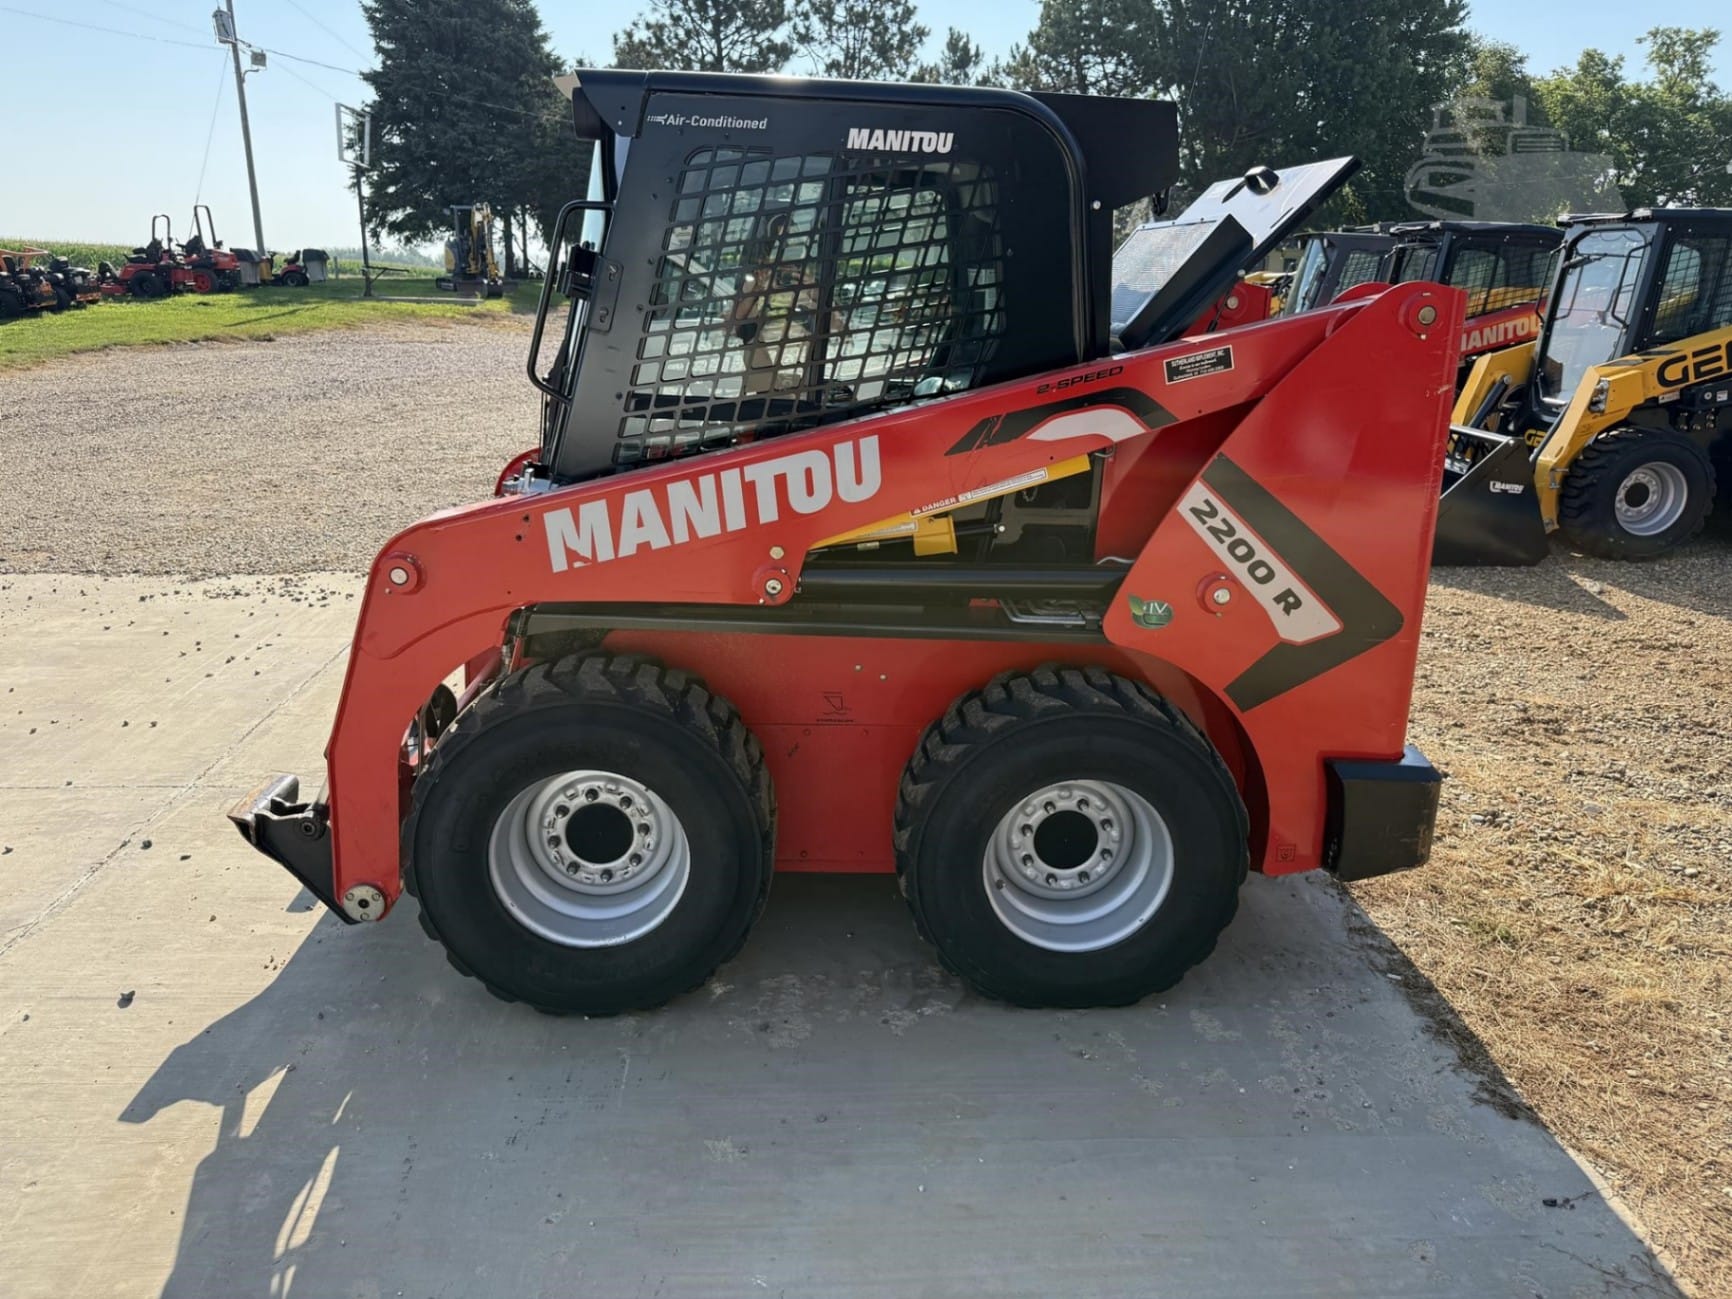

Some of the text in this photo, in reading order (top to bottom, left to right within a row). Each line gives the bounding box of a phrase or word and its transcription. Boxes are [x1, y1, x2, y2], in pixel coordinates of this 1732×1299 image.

[666, 113, 768, 129] Air-Conditioned
[847, 128, 954, 154] MANITOU
[1657, 340, 1732, 388] GE
[1037, 366, 1124, 394] 2-SPEED
[543, 435, 882, 573] MANITOU
[922, 496, 957, 512] DANGER
[1188, 498, 1303, 616] 2200 R
